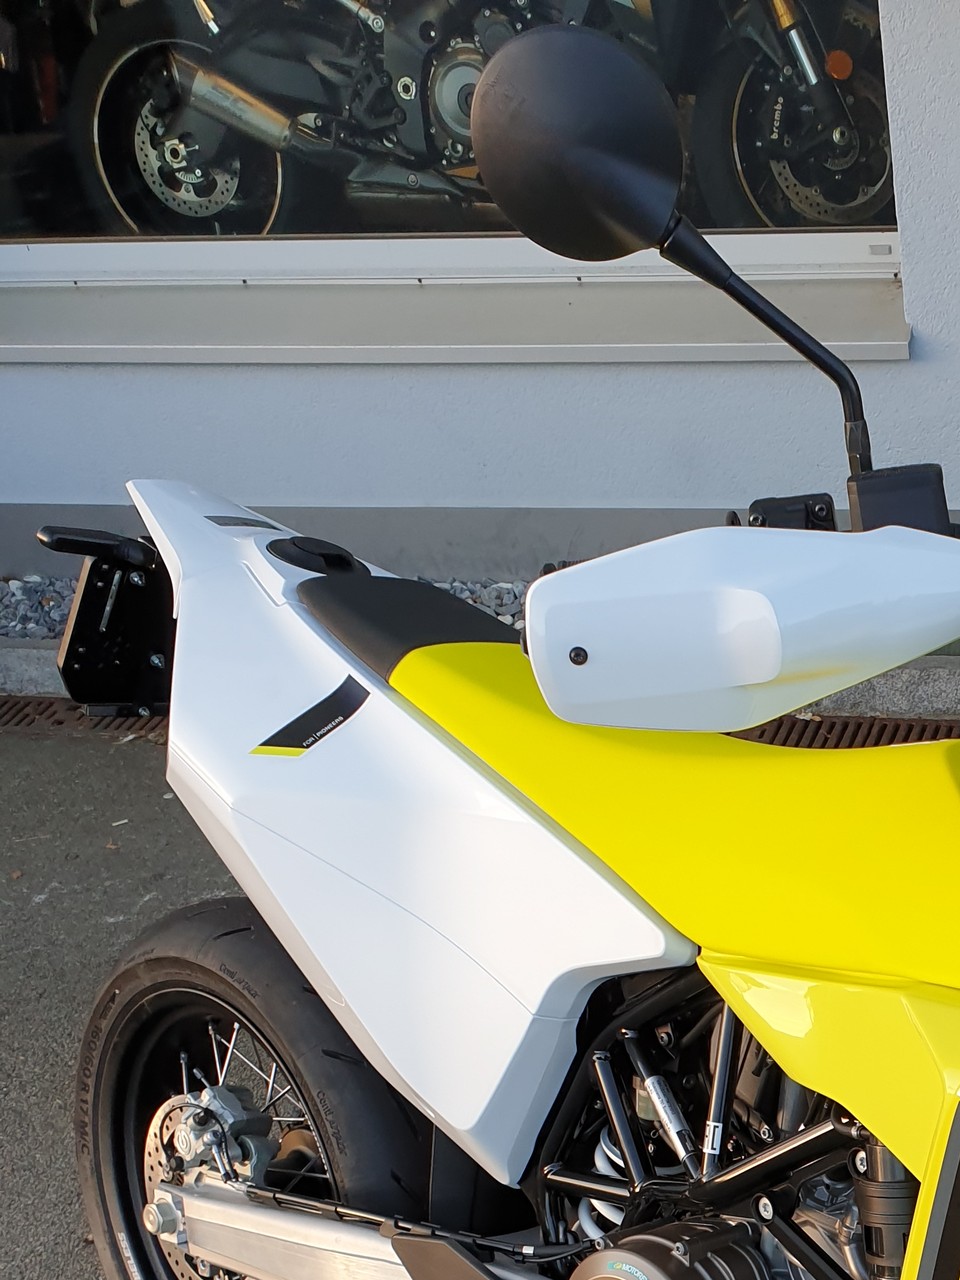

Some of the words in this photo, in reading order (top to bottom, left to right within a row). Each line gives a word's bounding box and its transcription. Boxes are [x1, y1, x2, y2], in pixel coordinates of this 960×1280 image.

[771, 96, 784, 140] brembo
[302, 736, 315, 748] FOR
[316, 716, 344, 737] PIONEERS
